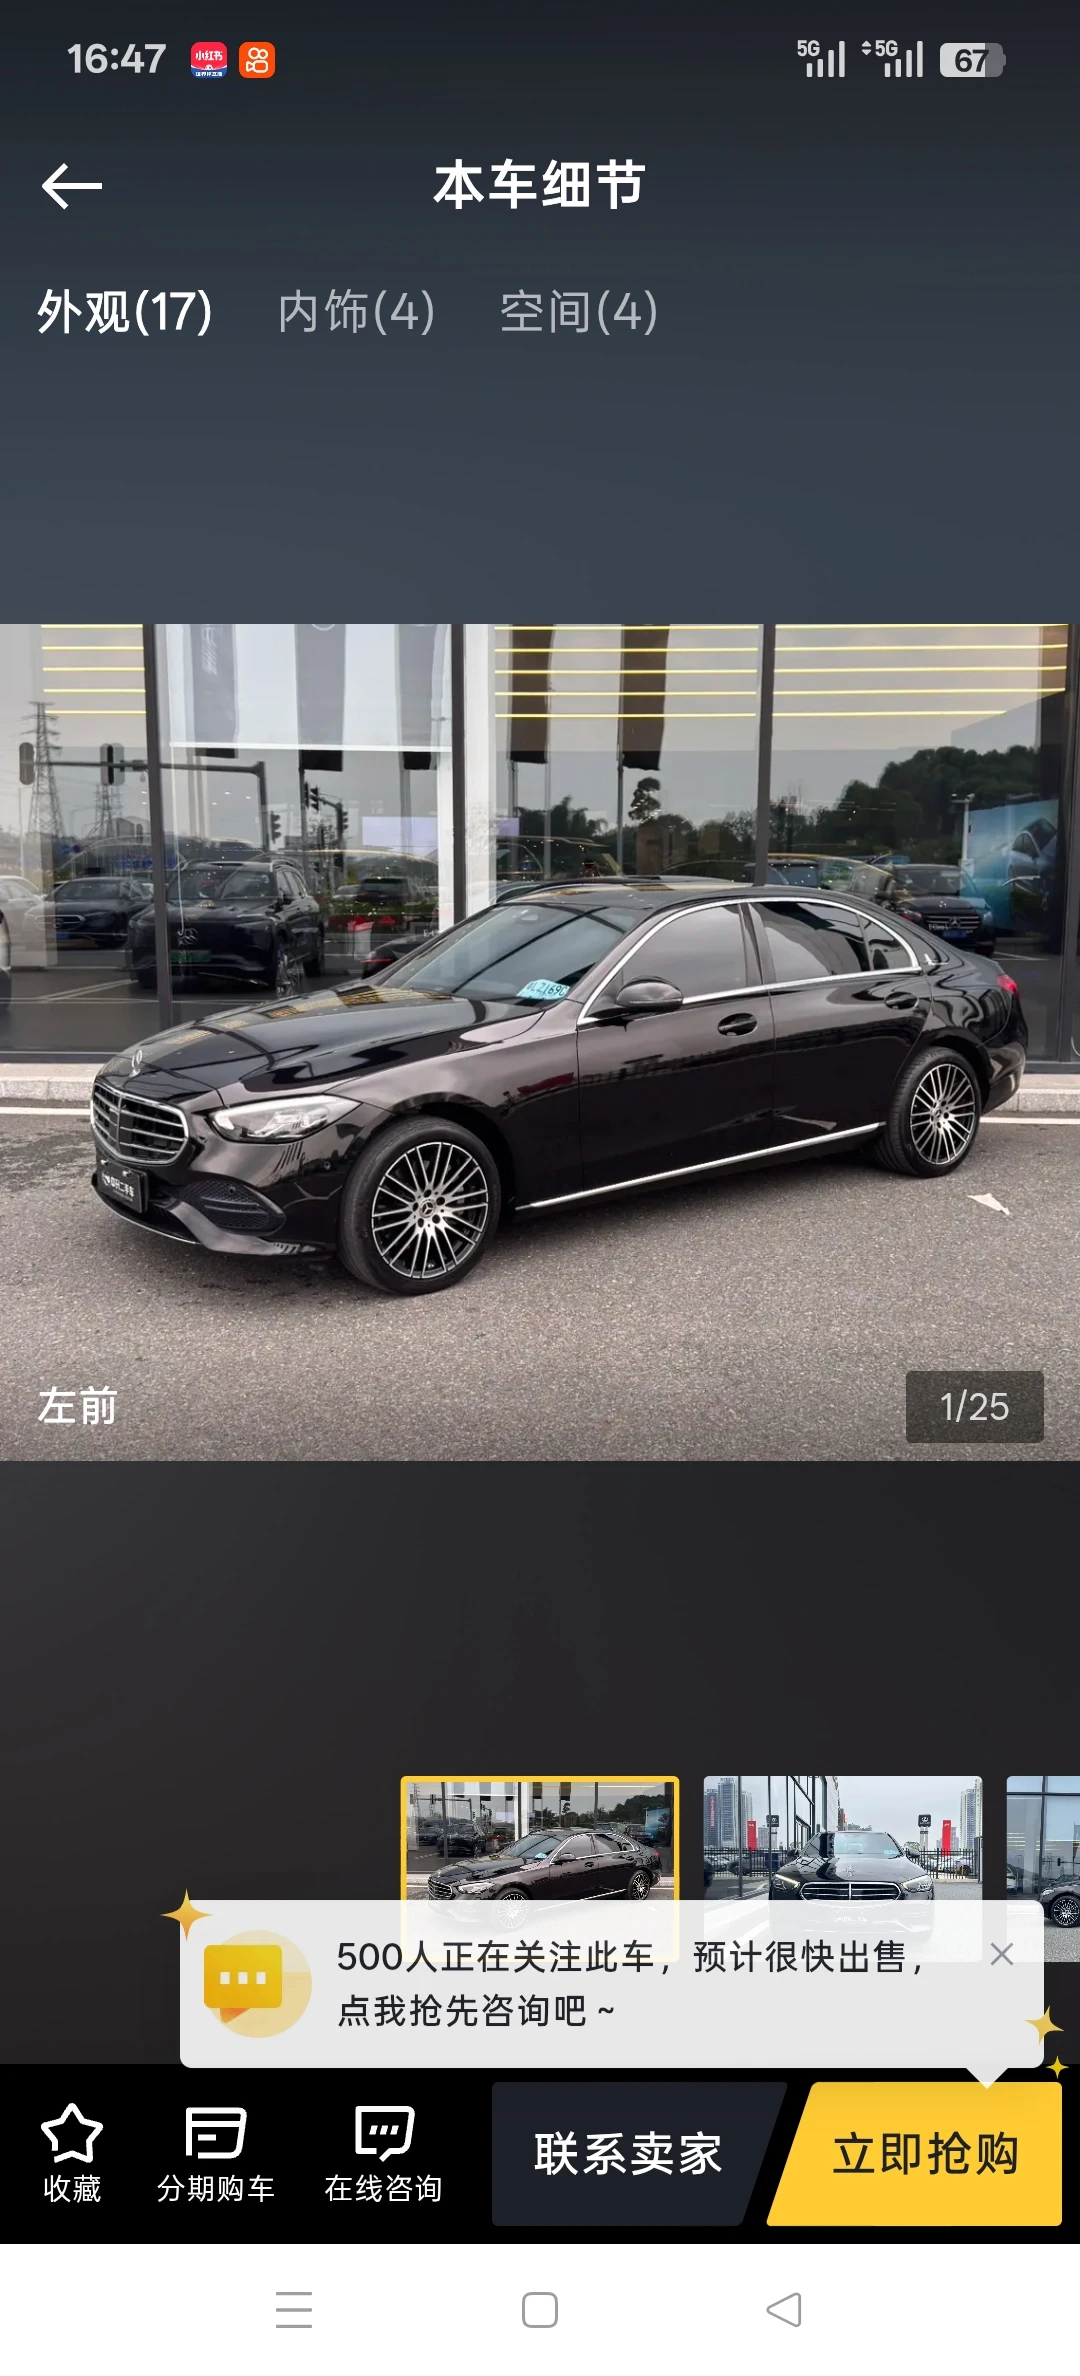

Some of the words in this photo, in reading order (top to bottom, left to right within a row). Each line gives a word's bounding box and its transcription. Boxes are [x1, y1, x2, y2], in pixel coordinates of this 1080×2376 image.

[67, 43, 167, 74] 16:47
[195, 50, 223, 61] 小红书
[797, 40, 821, 57] 5G
[875, 40, 899, 57] 5G
[955, 49, 989, 72] 67
[433, 158, 646, 209] 本车细节
[36, 288, 212, 336] 外观(17)
[279, 288, 435, 336] 内饰(4)
[500, 288, 658, 336] 空间(4)
[533, 2130, 723, 2176] 联系卖家
[833, 2130, 1019, 2176] 立即抢购
[43, 2173, 102, 2204] 收藏
[157, 2173, 275, 2203] 分期购车
[324, 2173, 442, 2203] 在线咨询
